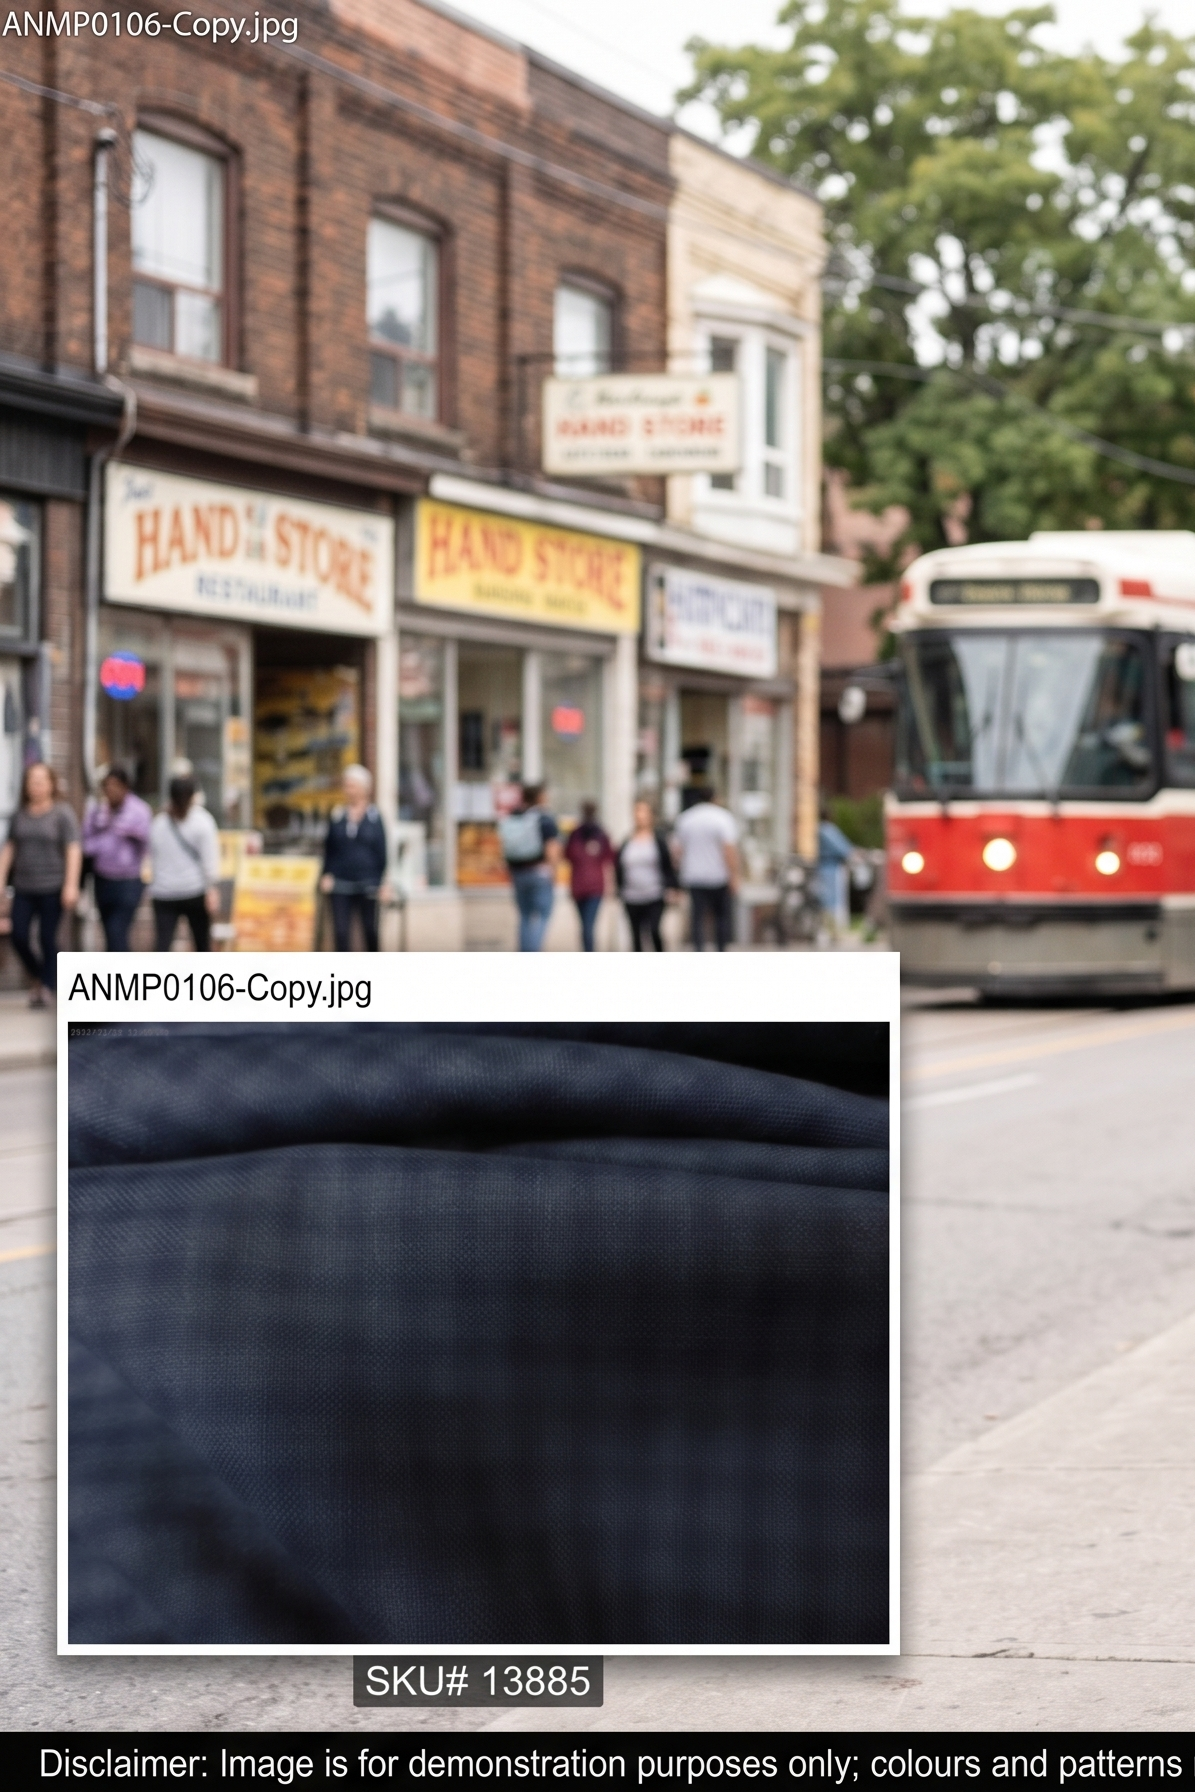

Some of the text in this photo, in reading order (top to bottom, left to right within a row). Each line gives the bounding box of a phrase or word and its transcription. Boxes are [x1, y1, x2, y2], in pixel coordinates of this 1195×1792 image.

[134, 503, 239, 584] HAND
[274, 512, 374, 614] STORE
[429, 514, 523, 580] HAND
[534, 534, 626, 611] STORE
